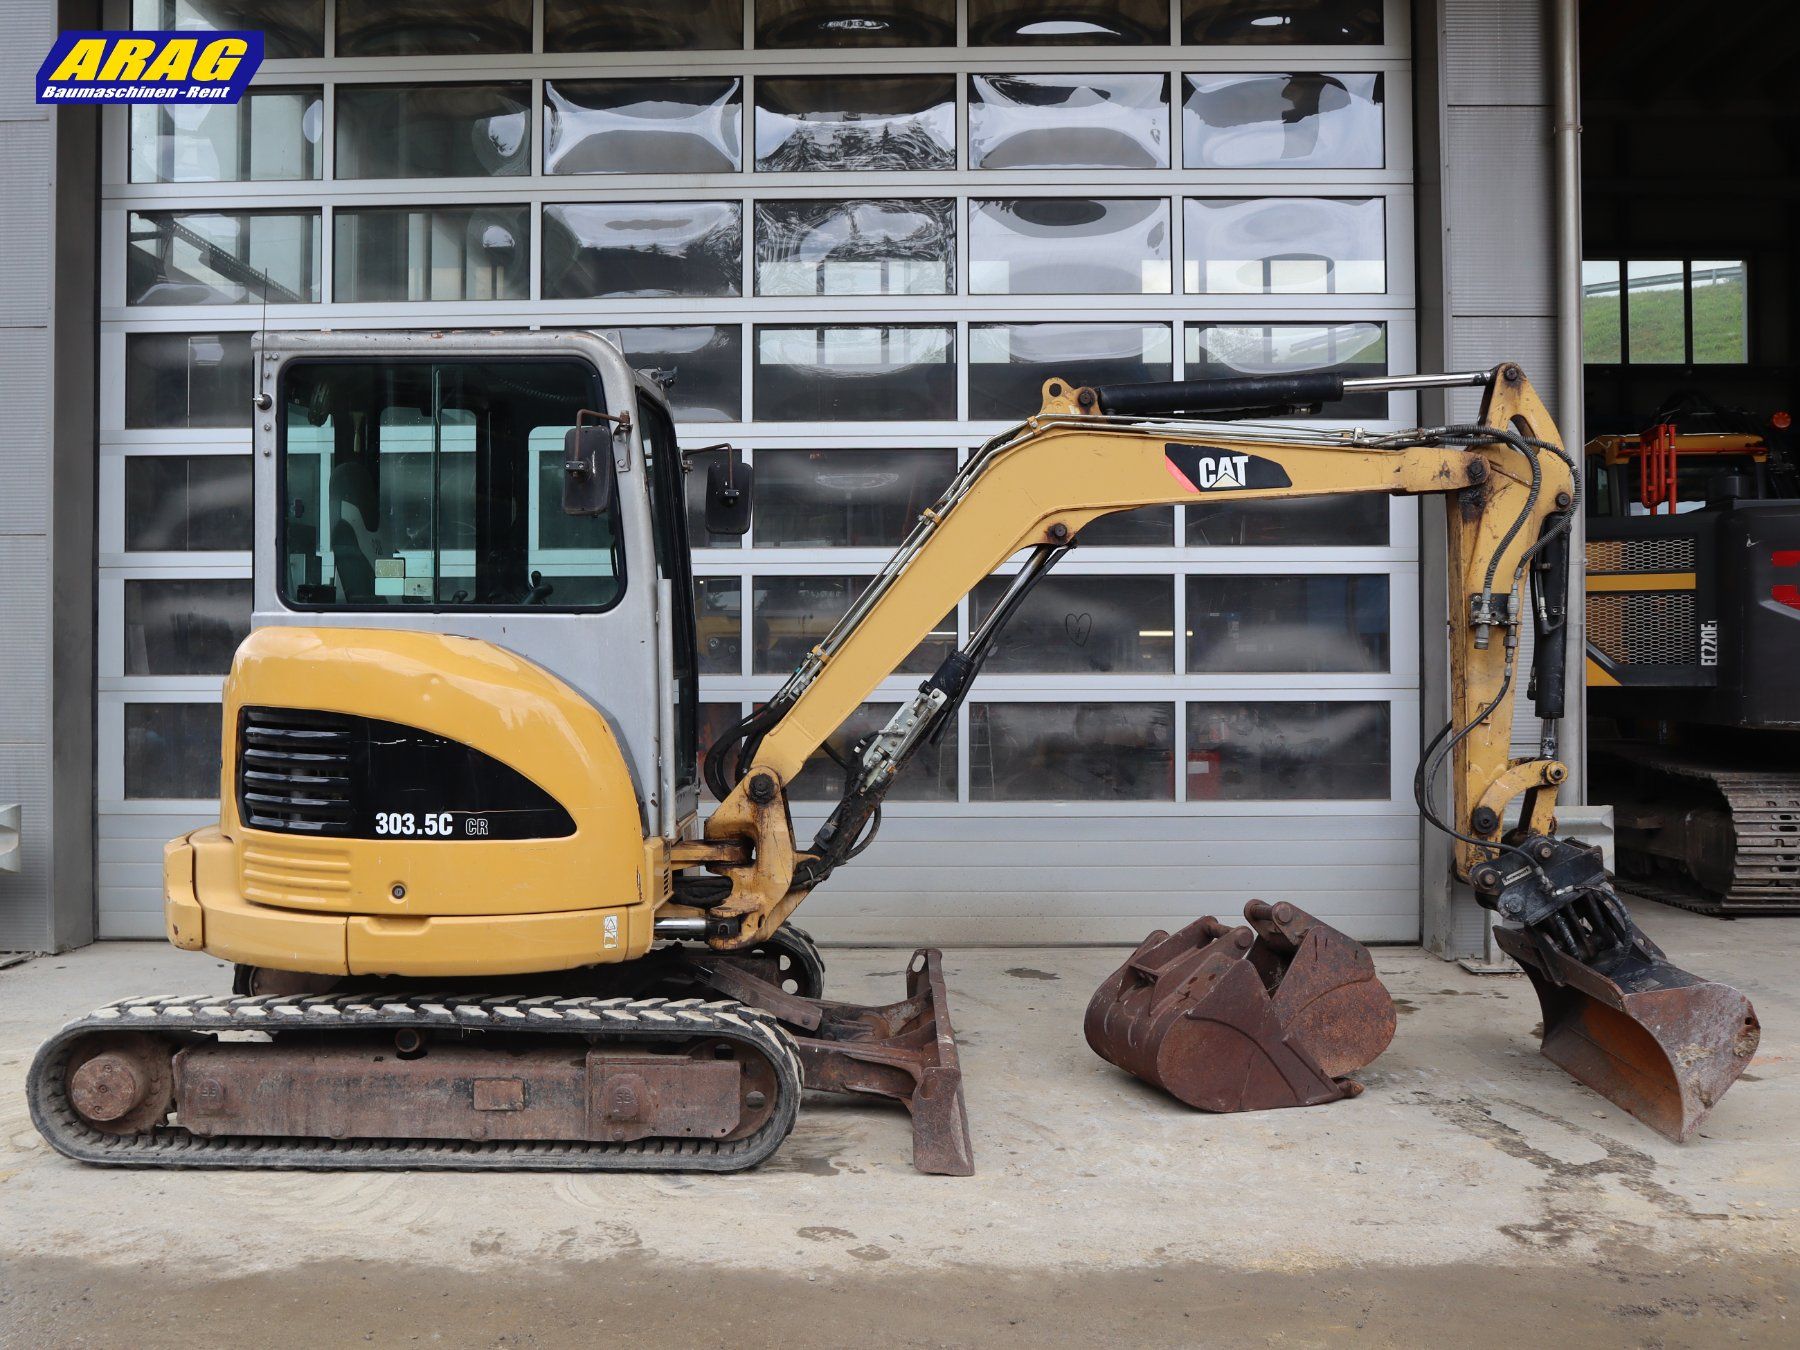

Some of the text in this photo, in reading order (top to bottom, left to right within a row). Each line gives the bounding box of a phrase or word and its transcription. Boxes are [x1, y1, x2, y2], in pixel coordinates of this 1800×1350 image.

[1198, 455, 1249, 489] CAT
[375, 812, 489, 836] 303.5C CR
